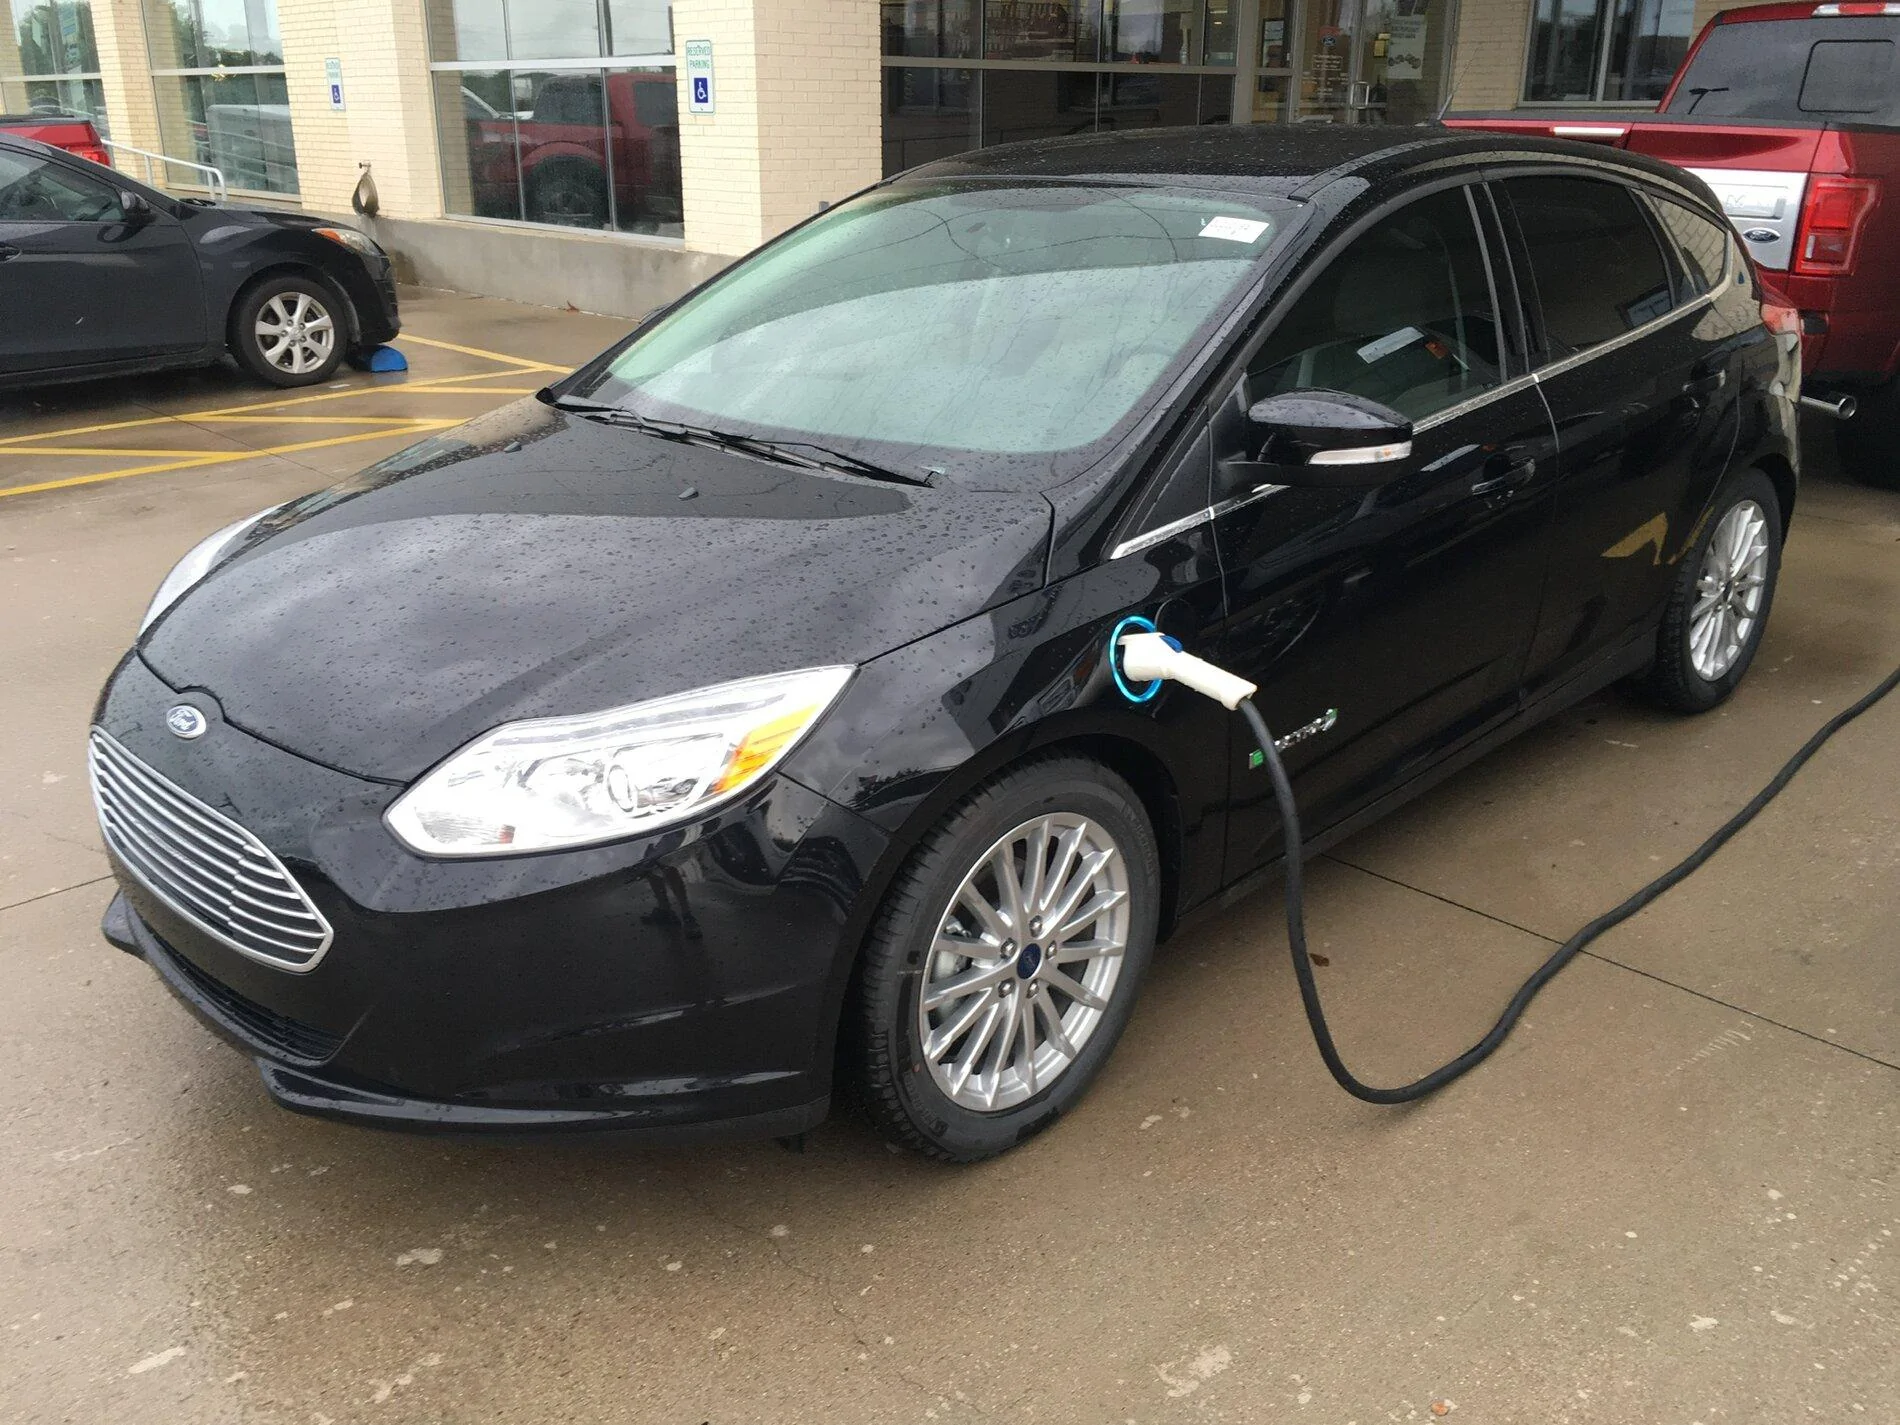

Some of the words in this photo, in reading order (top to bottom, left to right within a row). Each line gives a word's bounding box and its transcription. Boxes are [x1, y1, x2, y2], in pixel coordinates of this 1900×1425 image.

[687, 46, 711, 56] RESERVED
[689, 60, 710, 69] PARKING
[168, 708, 198, 731] Ford
